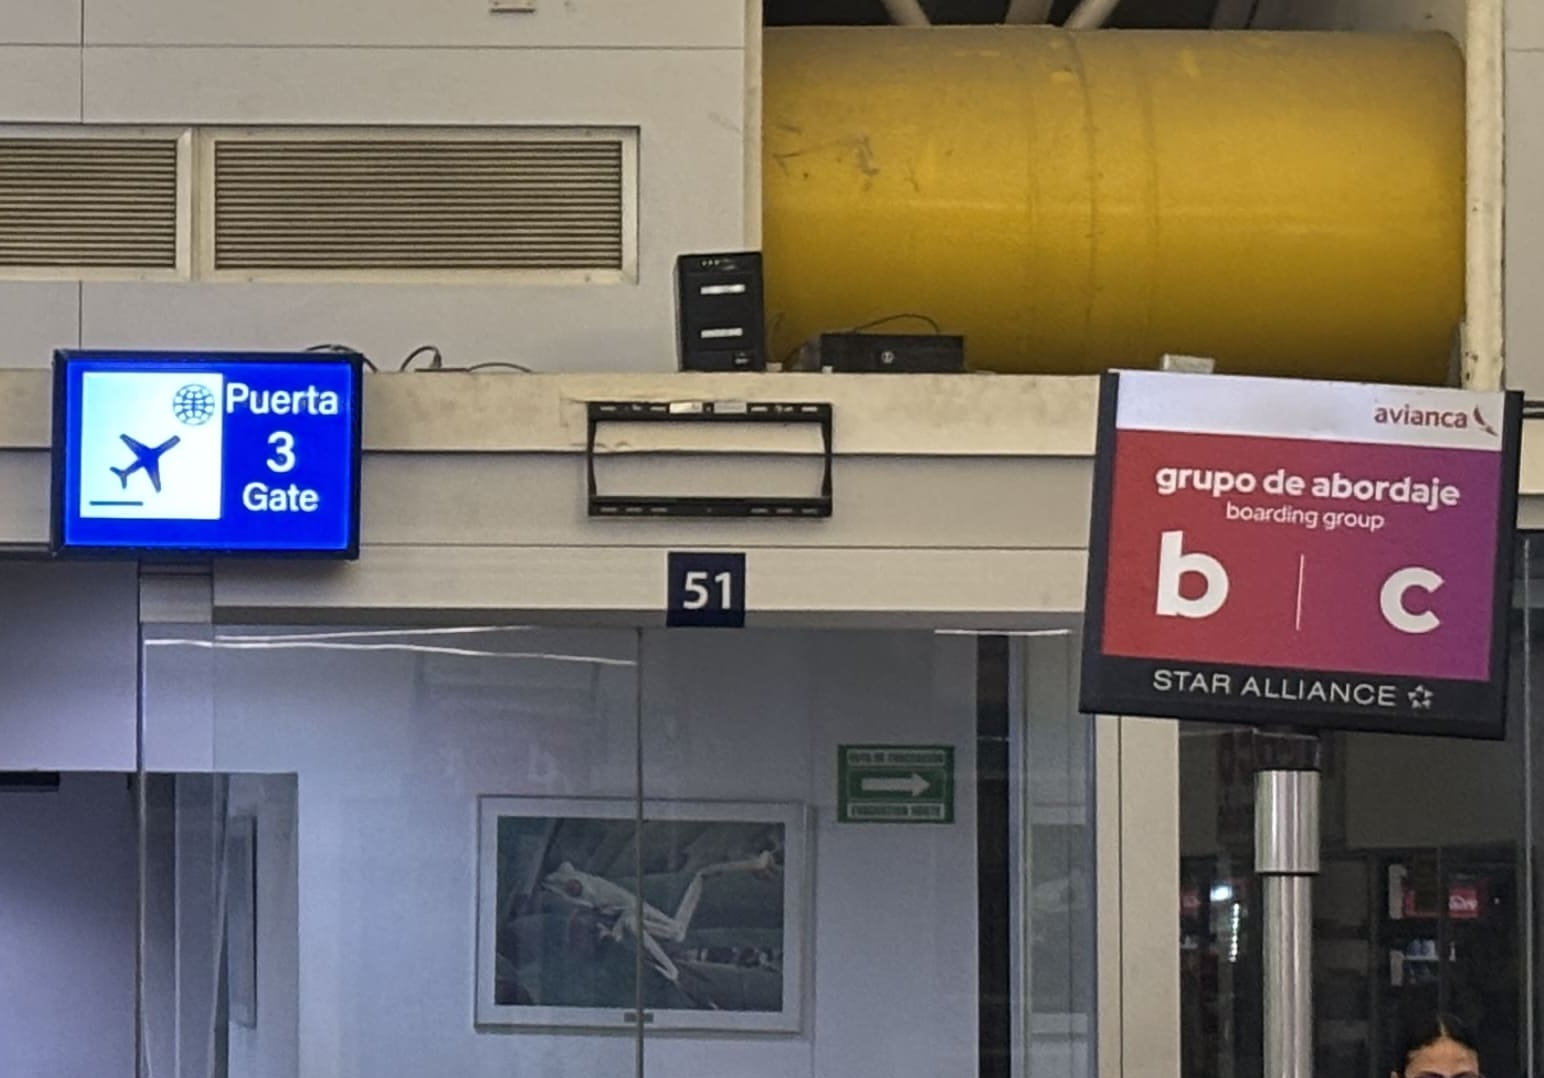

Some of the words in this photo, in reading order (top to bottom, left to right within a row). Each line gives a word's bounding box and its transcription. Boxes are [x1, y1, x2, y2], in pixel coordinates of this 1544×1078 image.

[225, 382, 339, 415] Puerta
[1374, 404, 1468, 429] avianca
[266, 430, 296, 473] 3
[242, 482, 320, 512] Gate
[1156, 467, 1256, 498] grupo
[1263, 468, 1305, 496] de
[1311, 473, 1460, 511] abordaje
[1226, 501, 1318, 529] boarding
[1323, 510, 1384, 531] group
[682, 571, 732, 610] 51
[1156, 530, 1229, 619] b
[1379, 566, 1444, 634] c
[1153, 669, 1233, 696] STAR
[1241, 675, 1396, 707] ALLIANCE
